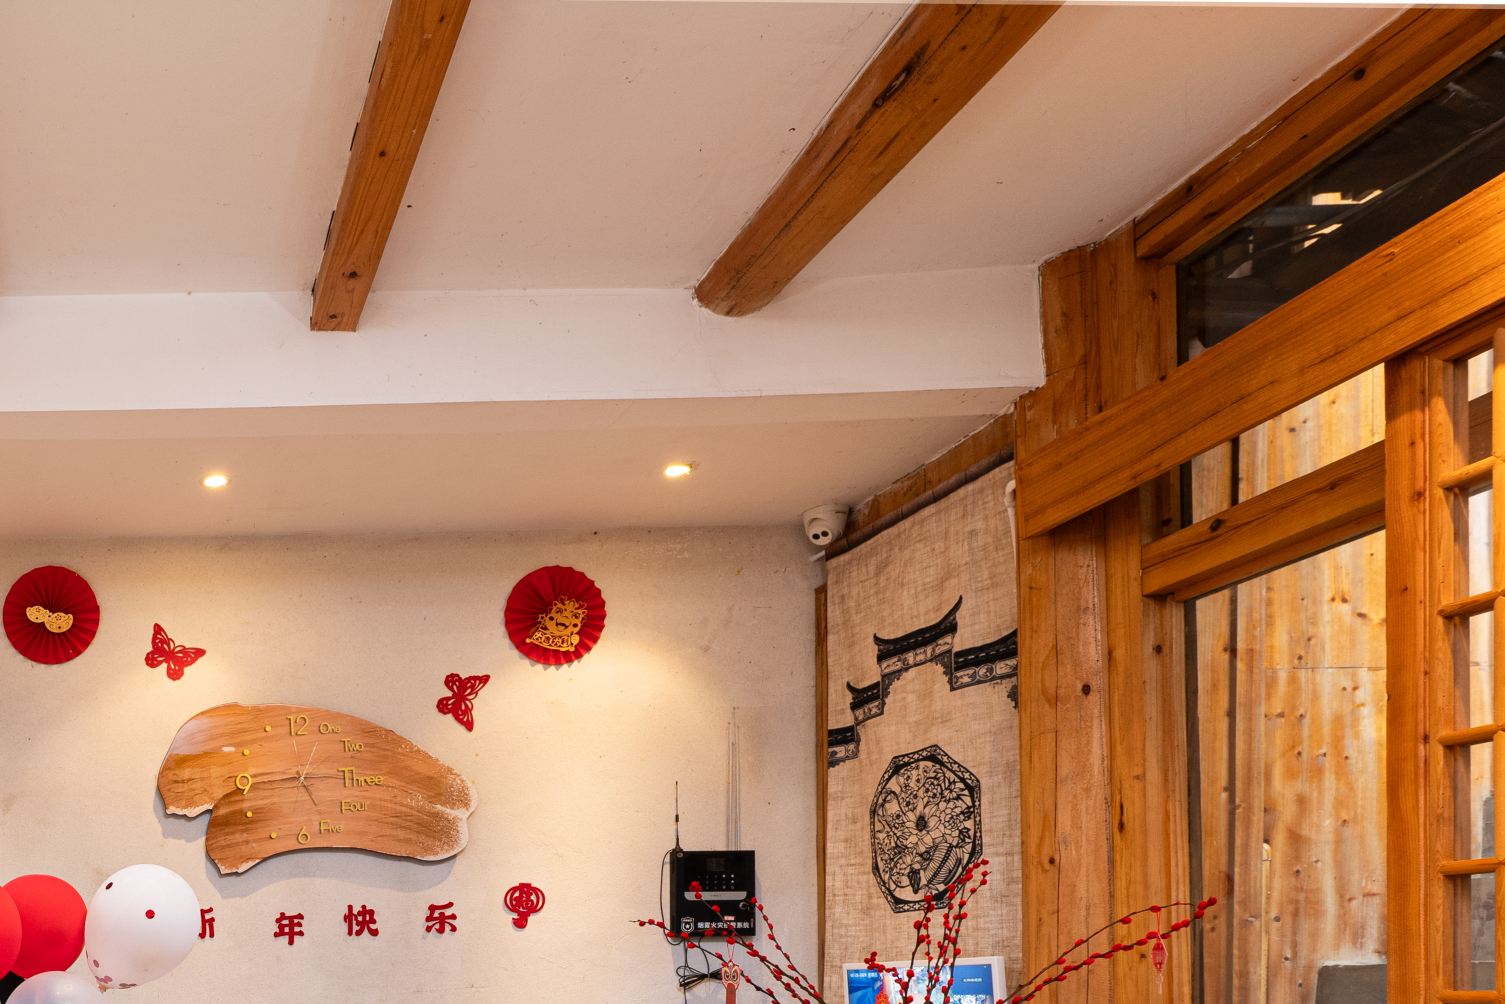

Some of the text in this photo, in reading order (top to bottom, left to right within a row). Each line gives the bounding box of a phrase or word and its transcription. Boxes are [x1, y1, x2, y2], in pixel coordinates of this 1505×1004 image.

[287, 715, 341, 735] 12 One
[341, 738, 364, 751] Two
[235, 773, 252, 794] 9
[338, 766, 383, 787] Three
[341, 800, 369, 813] Four
[298, 826, 310, 844] 6
[320, 819, 343, 834] Five
